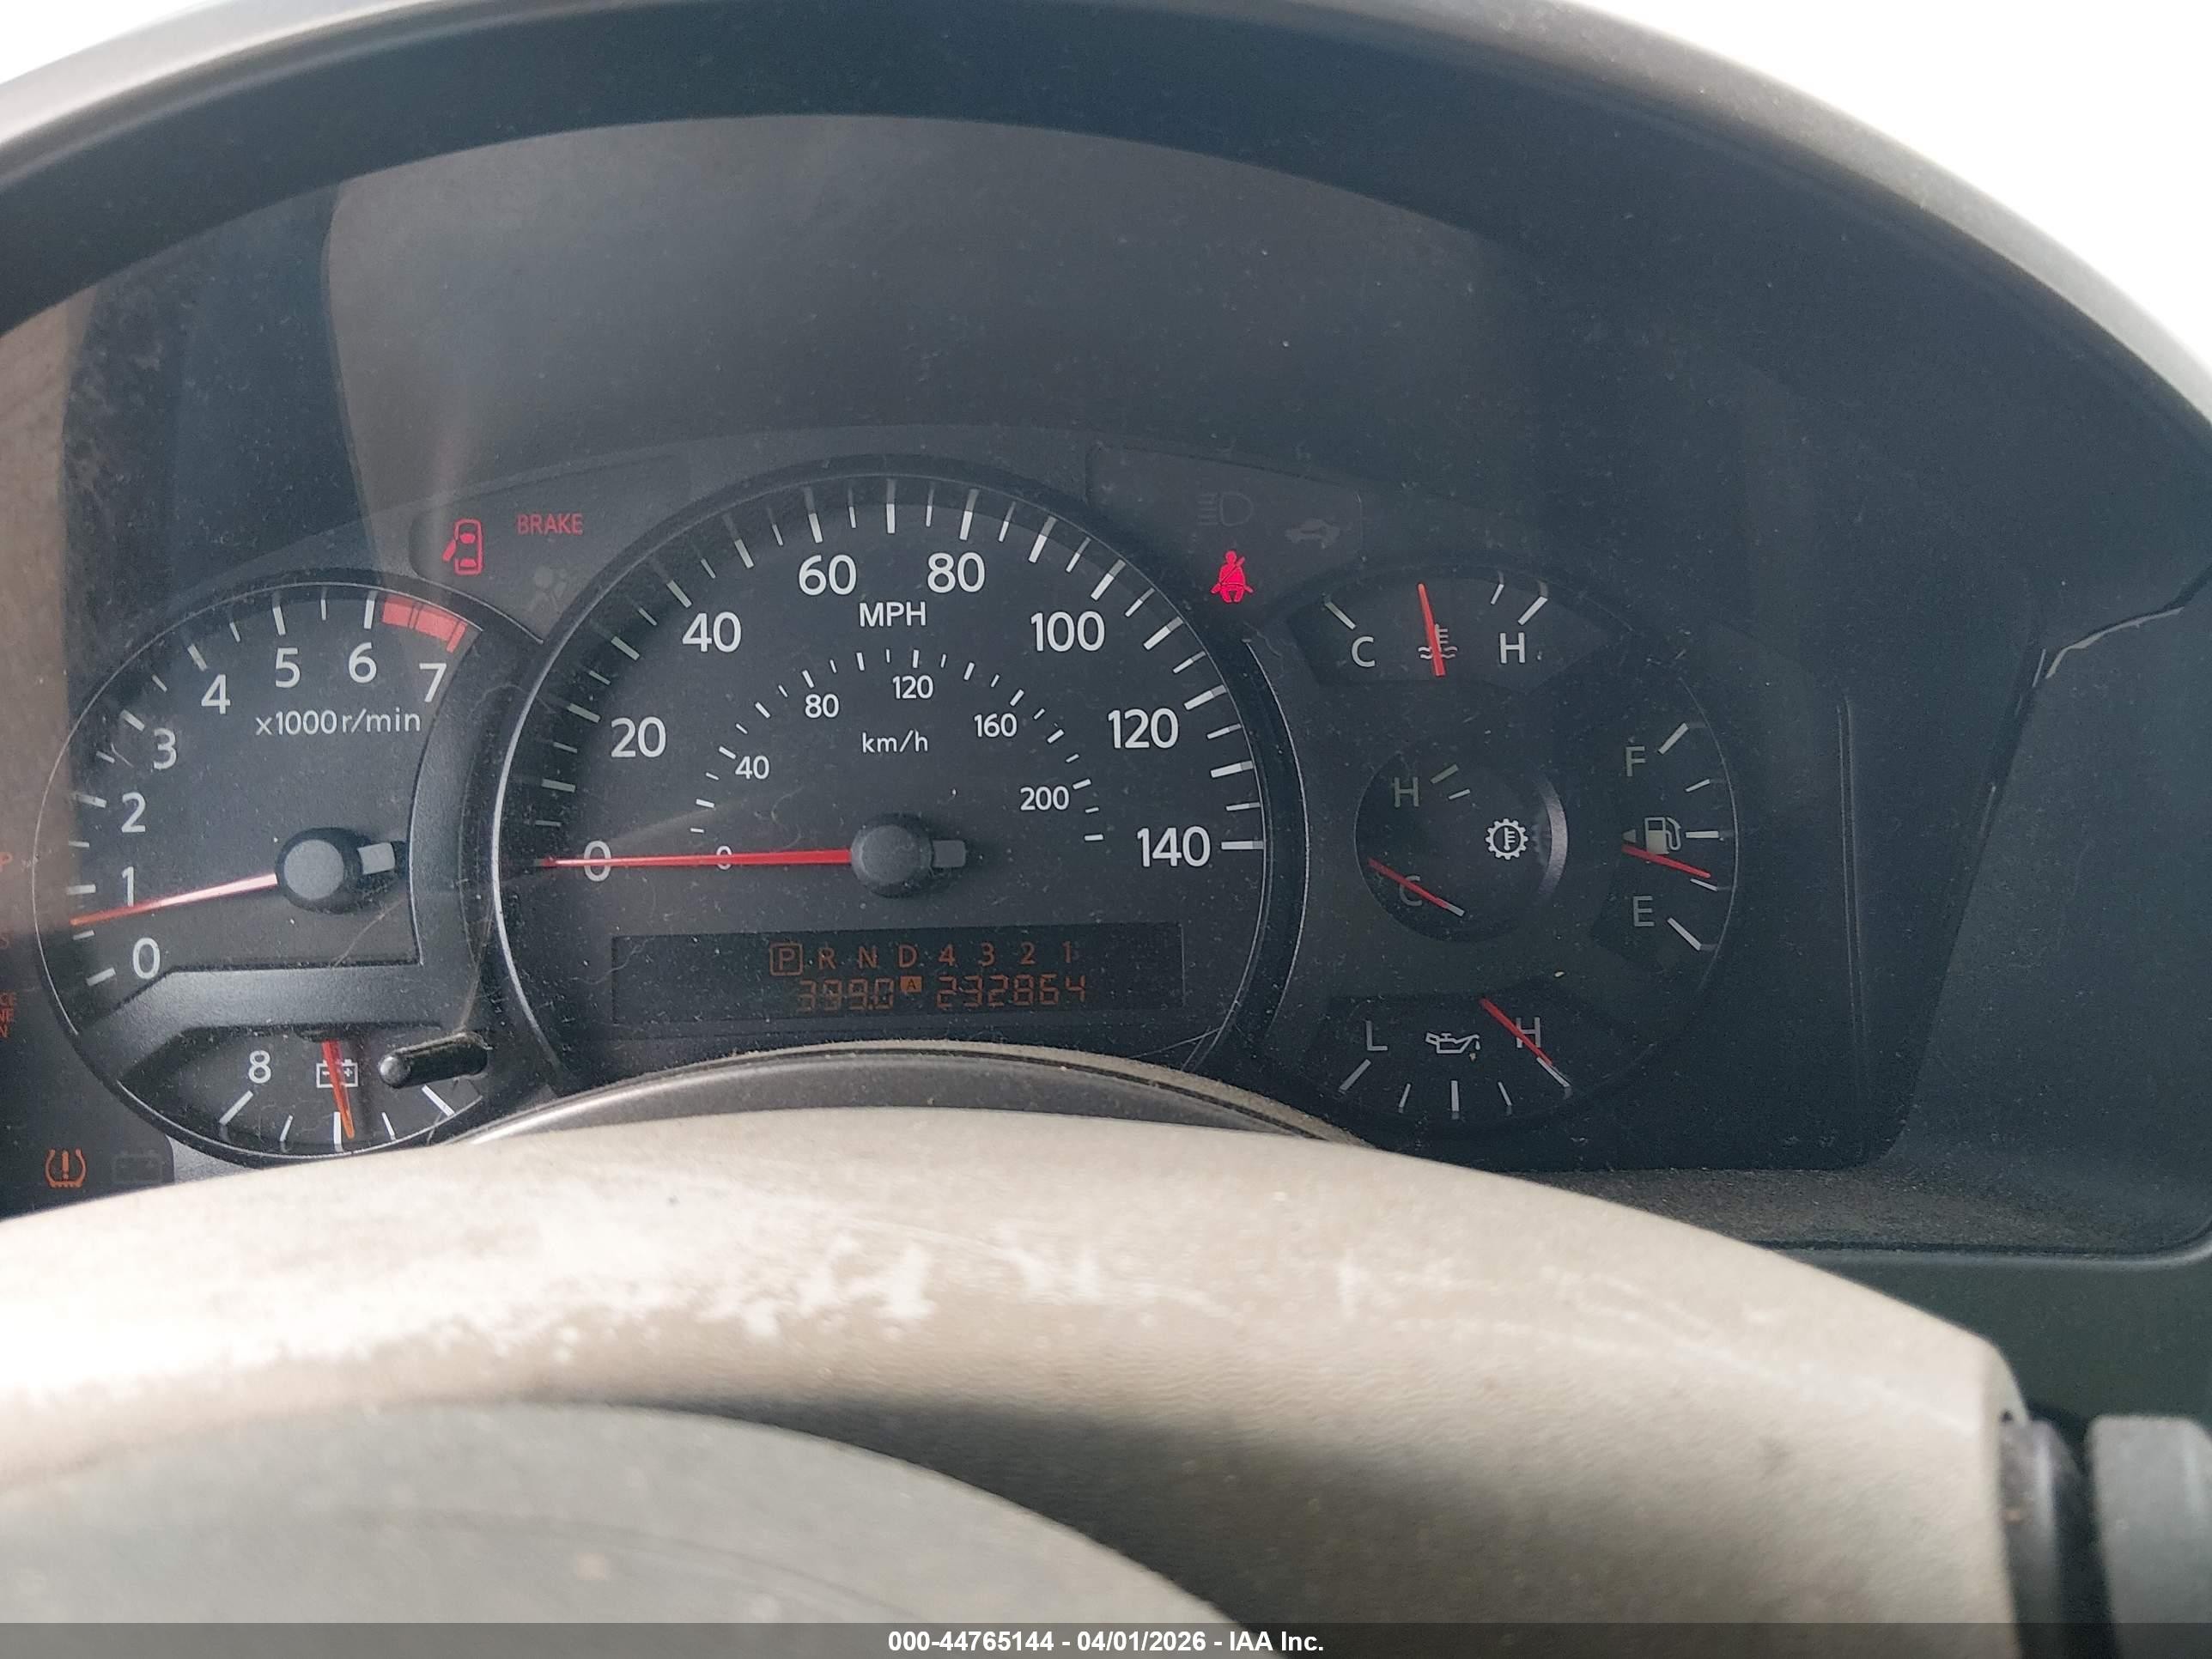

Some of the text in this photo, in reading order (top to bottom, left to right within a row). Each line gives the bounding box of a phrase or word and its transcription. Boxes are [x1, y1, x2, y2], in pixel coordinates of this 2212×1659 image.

[517, 514, 583, 536] BRAKE
[799, 555, 857, 595] 60
[927, 552, 985, 593] 80
[860, 602, 927, 626] MPH
[682, 612, 742, 653] 40
[1030, 611, 1106, 652] 100
[1499, 632, 1526, 663] H
[276, 648, 301, 688] 5
[349, 643, 378, 683] 6
[1351, 636, 1376, 667] C
[201, 674, 231, 714] 4
[419, 662, 447, 702] 7
[893, 675, 933, 699] 120
[805, 694, 839, 718] 80
[611, 717, 666, 758] 20
[862, 730, 928, 753] km/h
[974, 713, 1017, 737] 160
[1108, 708, 1179, 748] 120
[154, 729, 177, 769] 3
[1626, 746, 1645, 776] F
[735, 756, 770, 780] 40
[1020, 787, 1069, 811] 200
[1394, 777, 1419, 806] H
[122, 793, 146, 833] 2
[584, 841, 611, 882] 0
[1137, 826, 1211, 867] 140
[122, 867, 135, 906] 1
[1633, 895, 1654, 927] E
[132, 938, 161, 979] 0
[779, 941, 1072, 970] P R N D 4 3 2 1
[936, 974, 1086, 1008] 232864
[1366, 1021, 1388, 1051] L
[1516, 1018, 1540, 1048] H
[249, 1051, 271, 1084] 8
